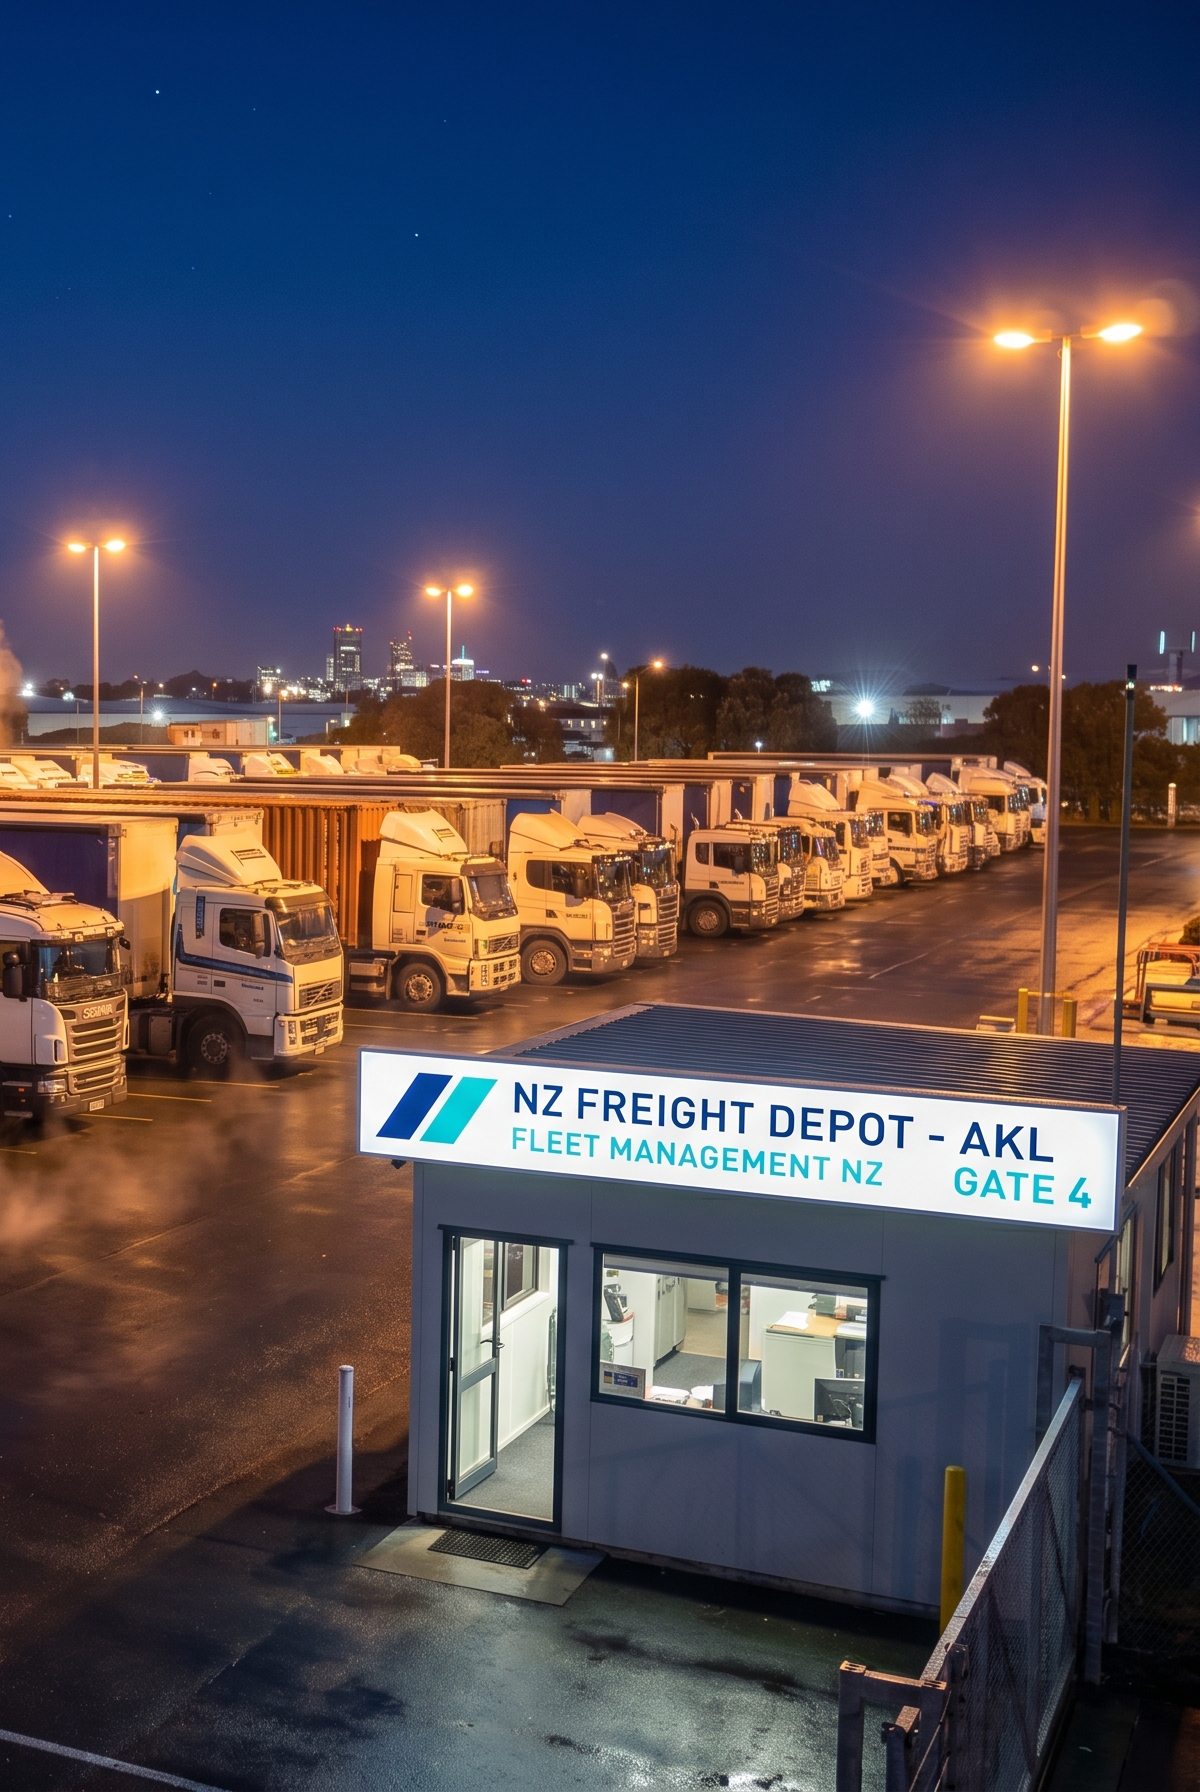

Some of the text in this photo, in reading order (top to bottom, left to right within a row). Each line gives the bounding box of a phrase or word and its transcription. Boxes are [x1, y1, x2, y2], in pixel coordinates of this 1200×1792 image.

[514, 1081, 564, 1118] NZ
[577, 1087, 755, 1135] FREIGHT
[769, 1104, 914, 1149] DEPOT
[959, 1121, 1054, 1163] AKL
[512, 1127, 883, 1187] FLEET MANAGEMENT NZ
[953, 1166, 1093, 1209] GATE 4
